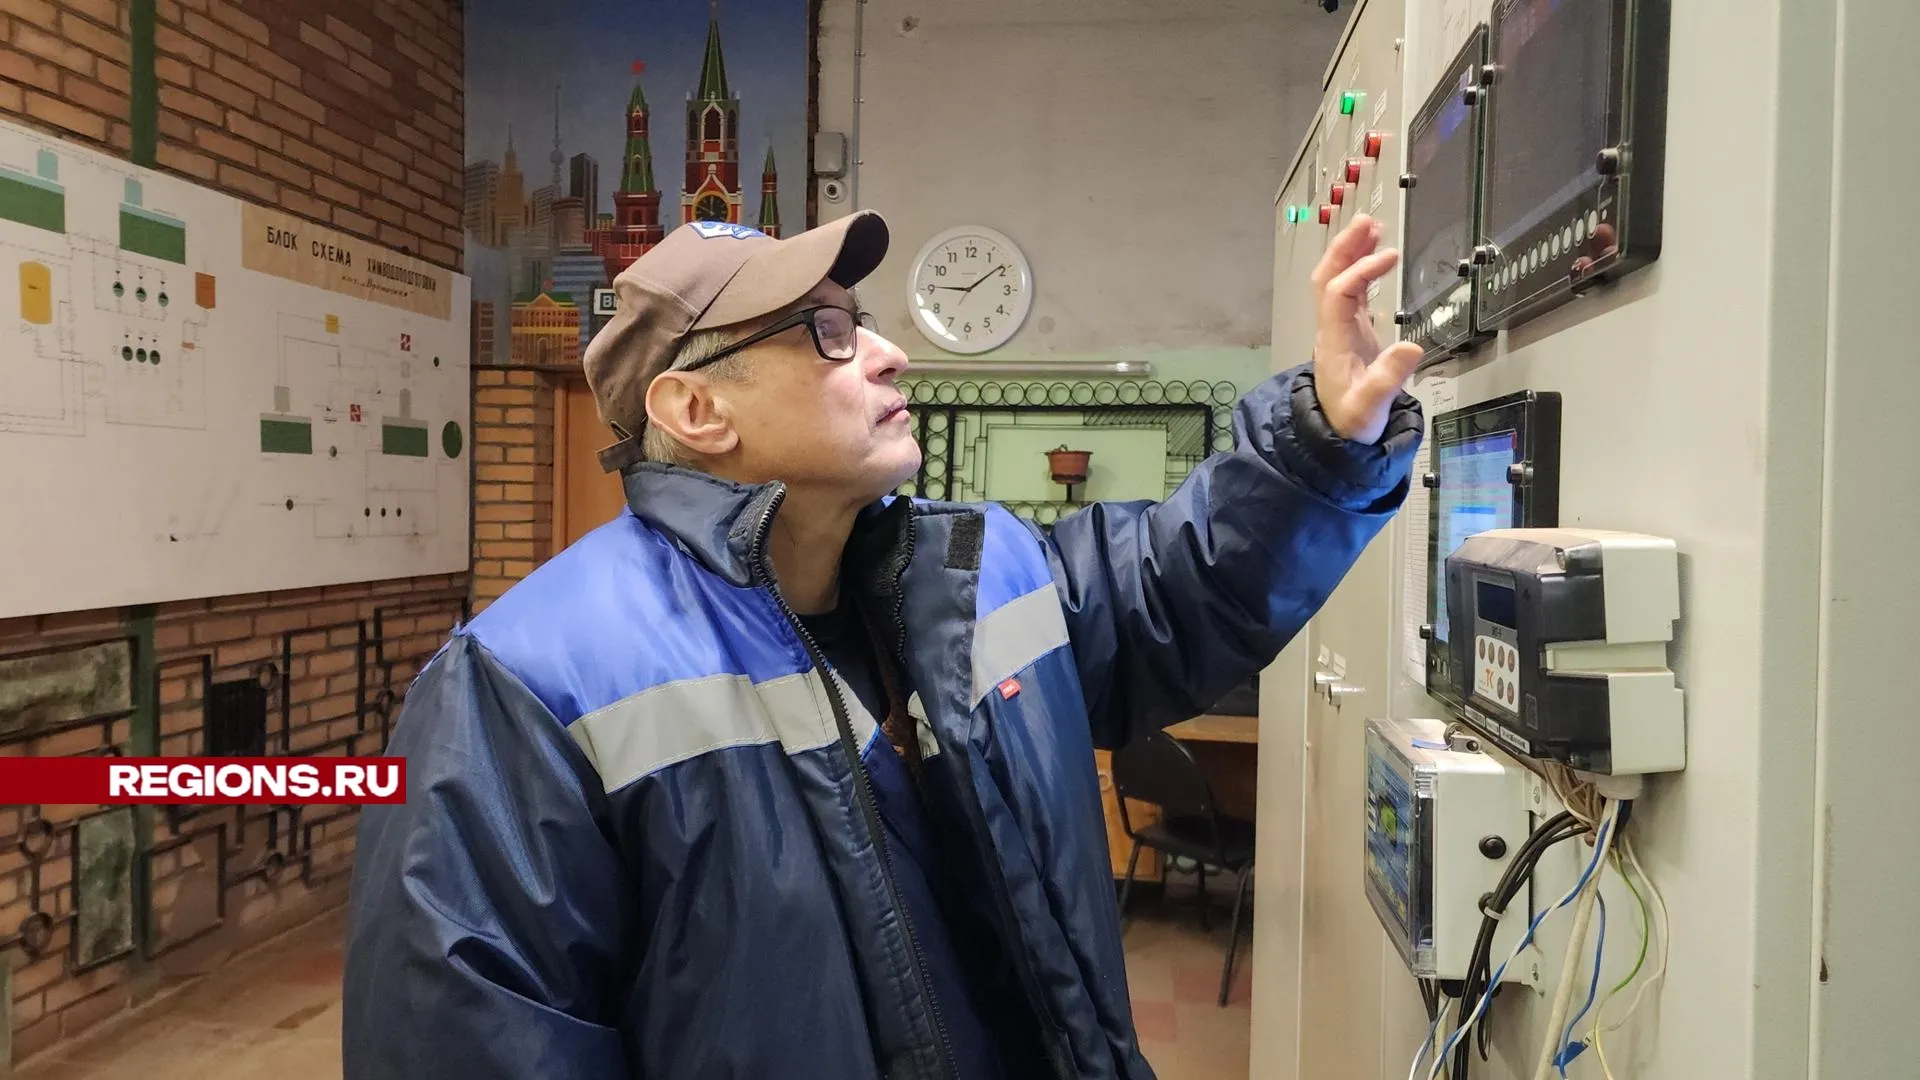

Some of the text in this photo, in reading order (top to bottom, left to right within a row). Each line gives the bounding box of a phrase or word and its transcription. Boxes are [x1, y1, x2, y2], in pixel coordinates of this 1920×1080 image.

[267, 226, 298, 251] БЛОК
[312, 241, 351, 267] СХЕМА
[965, 246, 977, 258] 12
[948, 252, 957, 263] 11
[987, 252, 992, 263] 1
[934, 265, 947, 276] 10
[998, 265, 1006, 277] 2
[927, 284, 935, 295] 9
[1003, 284, 1011, 296] 3
[933, 303, 940, 314] 8
[996, 304, 1004, 315] 4
[947, 317, 954, 328] 7
[964, 322, 971, 333] 6
[983, 317, 990, 328] 5
